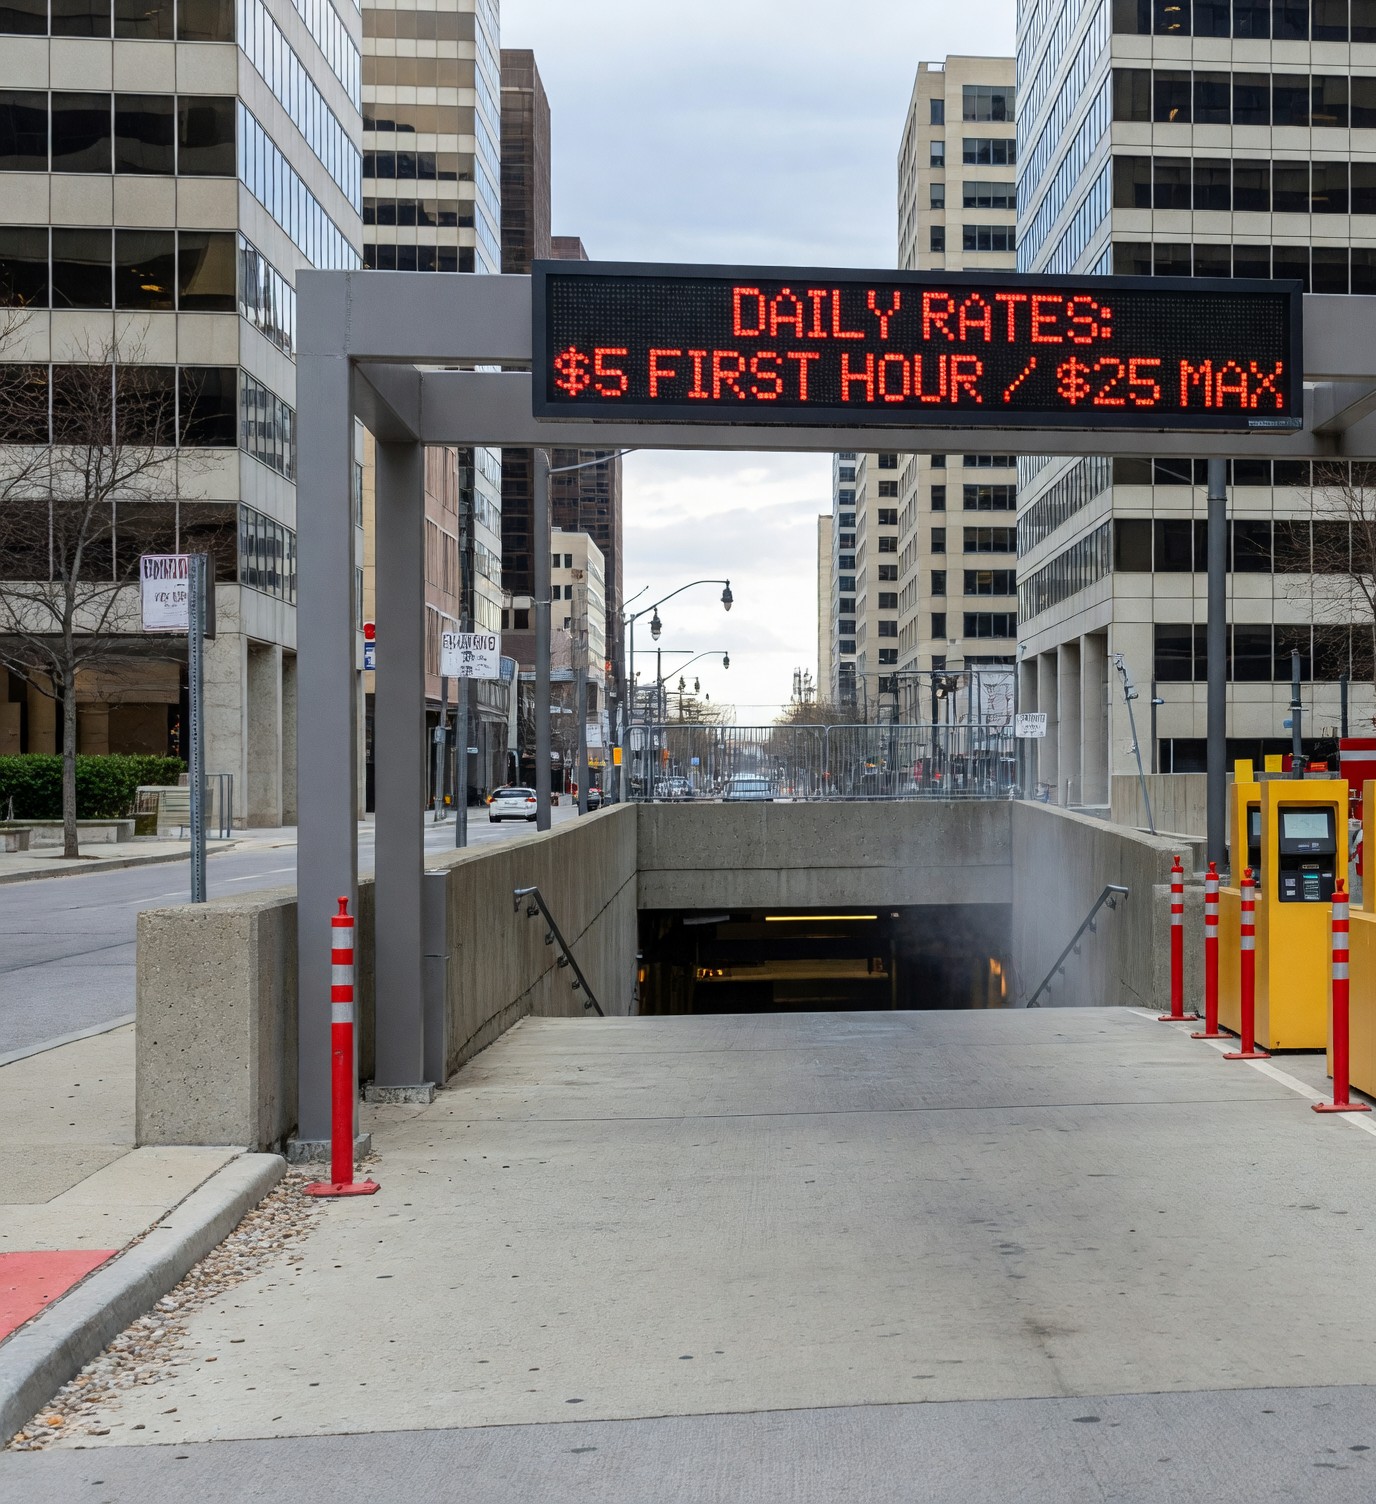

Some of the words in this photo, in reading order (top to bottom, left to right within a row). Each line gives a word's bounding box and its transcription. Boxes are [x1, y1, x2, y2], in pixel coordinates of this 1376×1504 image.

[732, 287, 901, 339] DAILY
[922, 291, 1112, 344] RATES:
[554, 346, 629, 397] $5
[649, 348, 820, 401] FIRST
[841, 352, 983, 403] HOUR
[1003, 356, 1037, 403] /
[1056, 356, 1161, 406] $25
[1179, 359, 1283, 409] MAX
